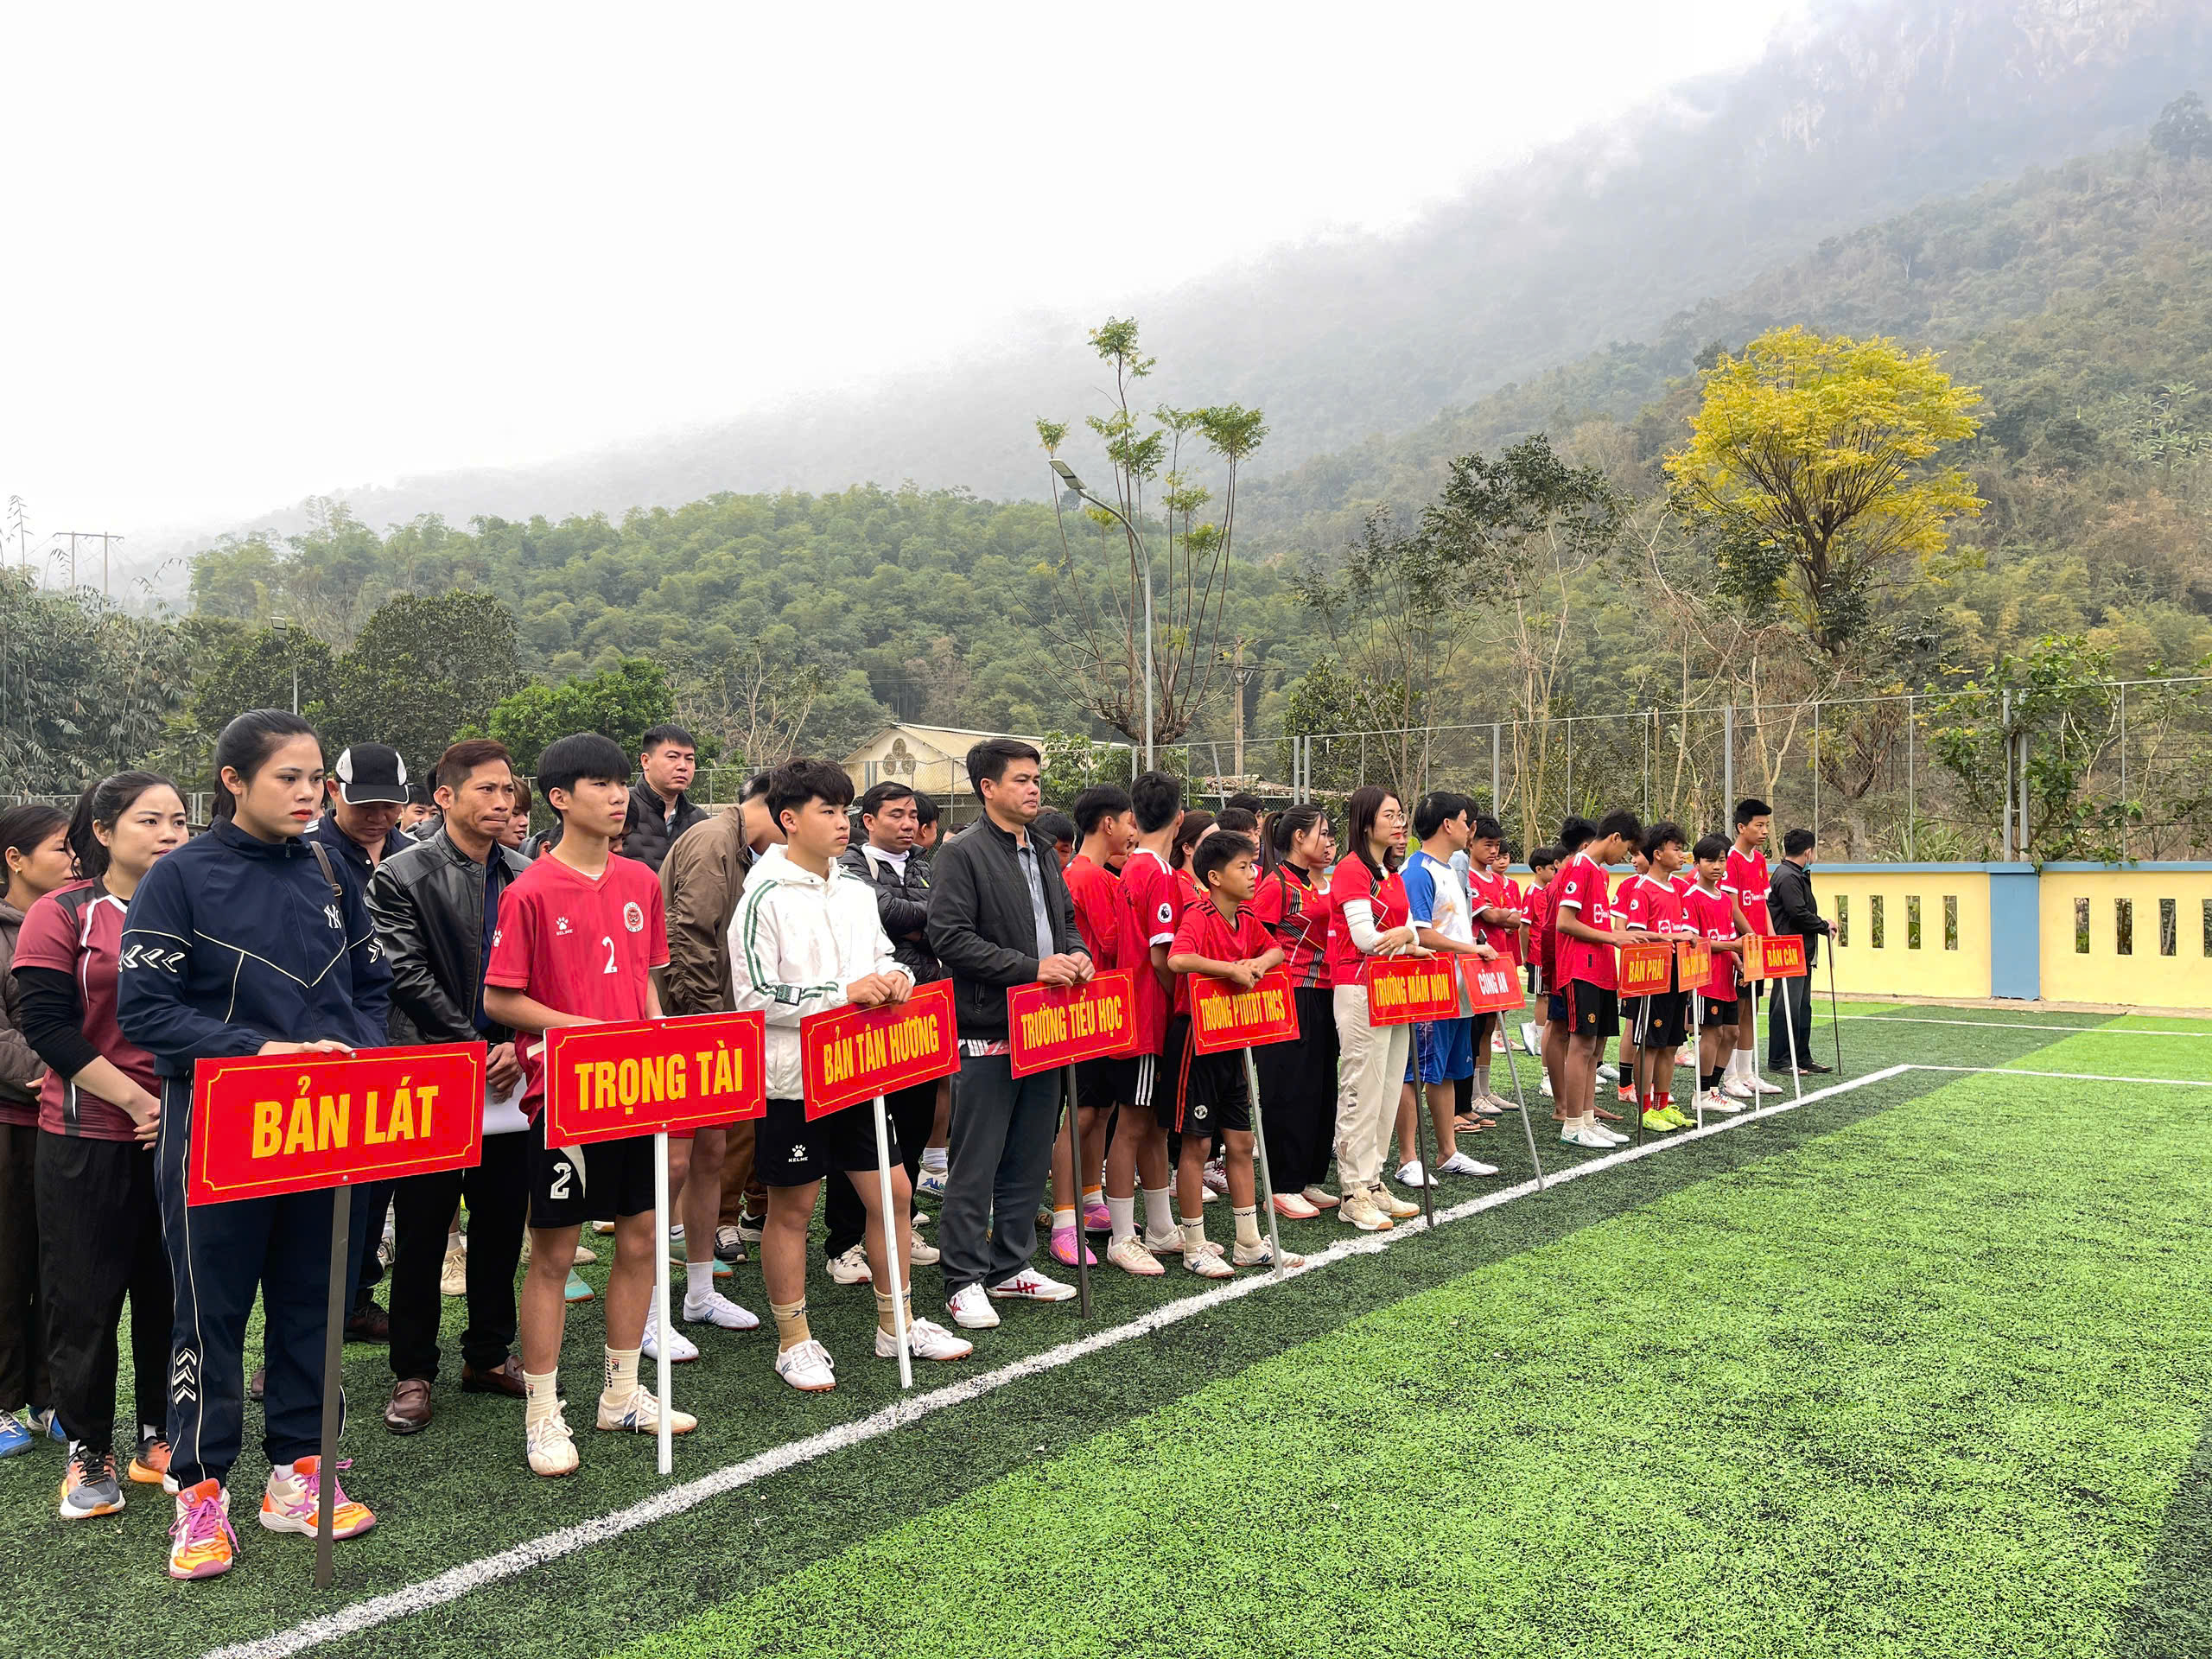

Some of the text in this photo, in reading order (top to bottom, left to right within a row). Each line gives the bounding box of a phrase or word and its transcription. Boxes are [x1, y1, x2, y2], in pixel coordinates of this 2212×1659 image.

[602, 936, 618, 974] 2
[1628, 952, 1646, 982] BẢN
[1430, 974, 1451, 1001] NON
[1478, 969, 1509, 995] CÔNG AN
[1020, 988, 1122, 1051] TRƯỜNG TIỂU HỌC
[1199, 988, 1286, 1032] TRƯỜNG PTDTBT THCS
[823, 1014, 940, 1086] BẢN TÂN HƯƠNG
[574, 1039, 743, 1116] TRỌNG TÀI
[251, 1075, 439, 1159] BẢN LÁT
[550, 1162, 572, 1199] 2
